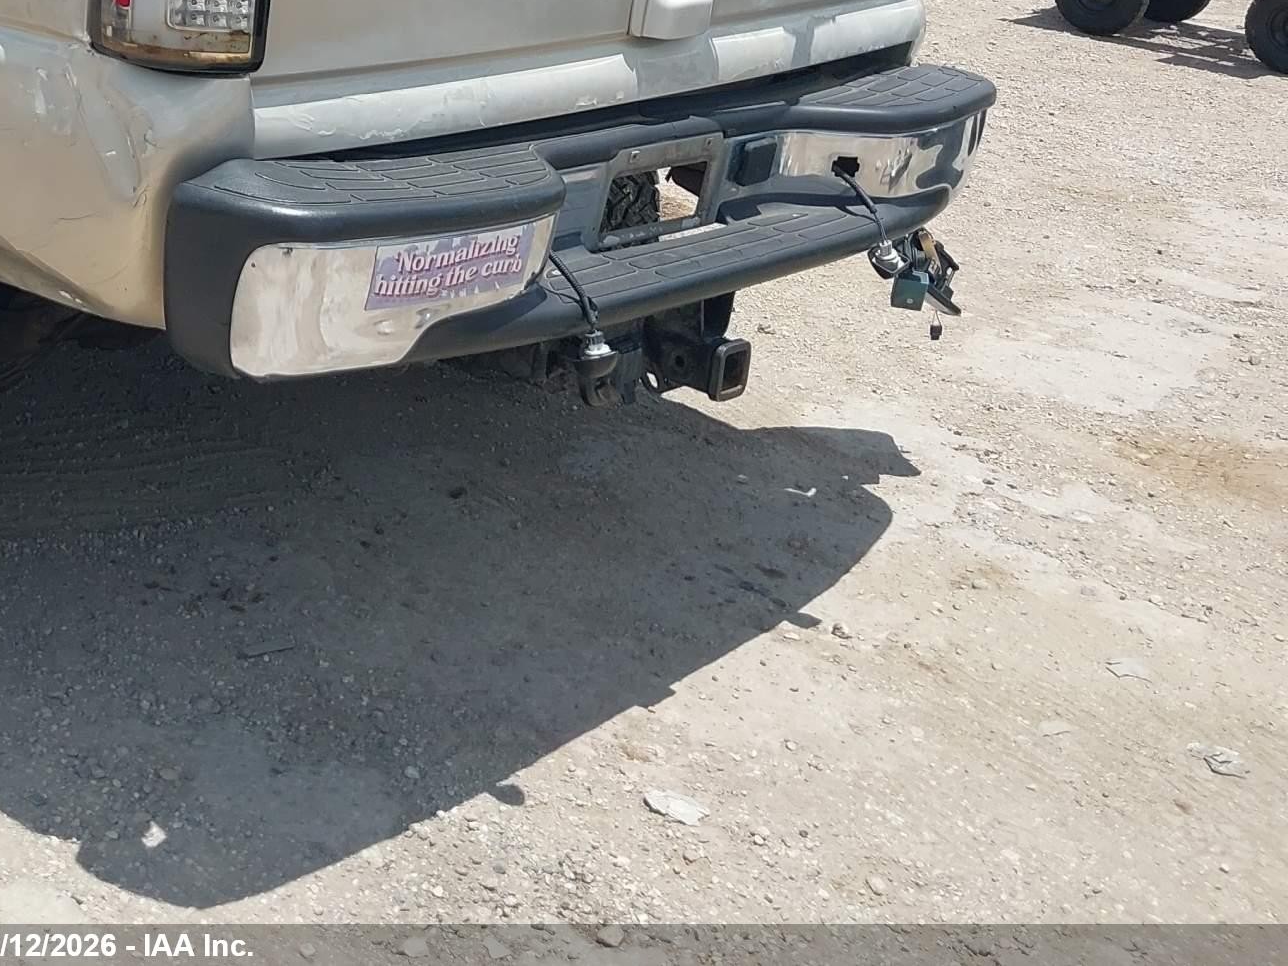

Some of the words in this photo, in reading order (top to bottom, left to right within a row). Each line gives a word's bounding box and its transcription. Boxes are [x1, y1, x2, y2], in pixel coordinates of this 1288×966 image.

[396, 234, 520, 274] Normalizing
[374, 274, 443, 298] hitting
[445, 264, 478, 287] the
[481, 253, 523, 277] curb
